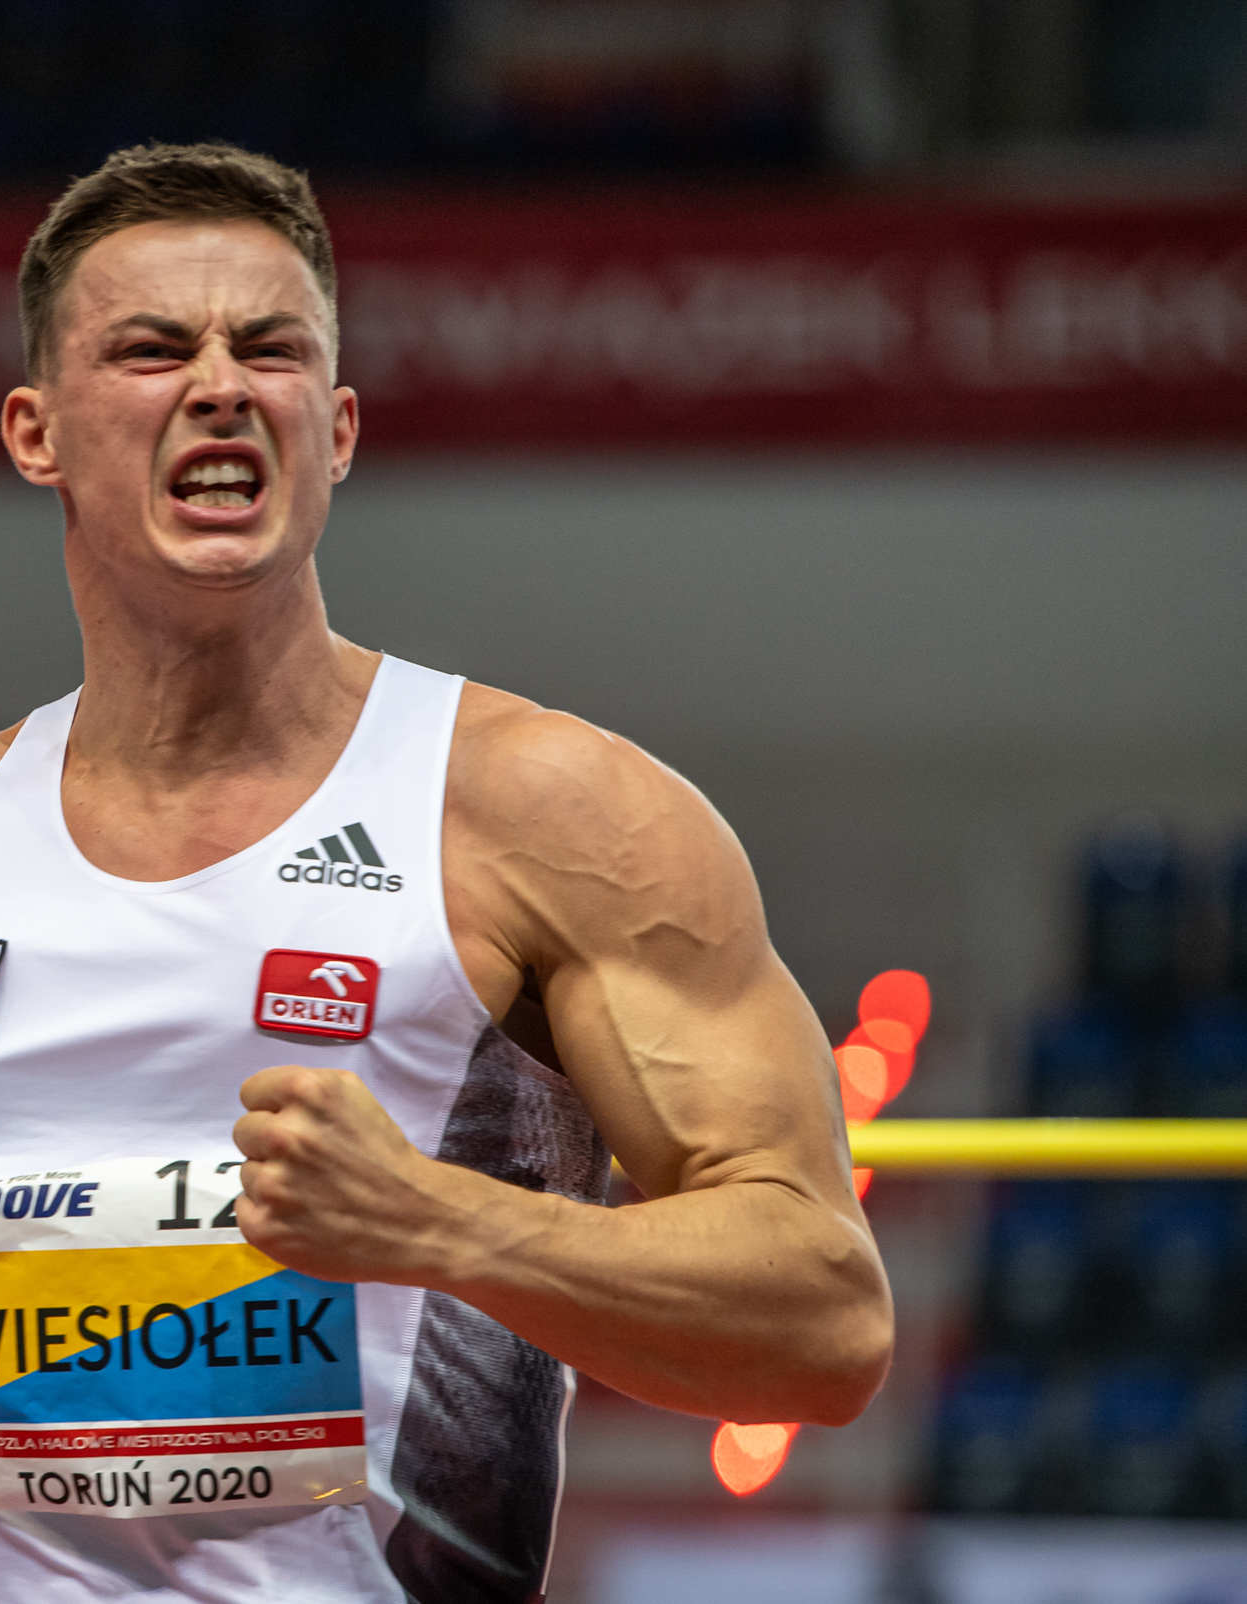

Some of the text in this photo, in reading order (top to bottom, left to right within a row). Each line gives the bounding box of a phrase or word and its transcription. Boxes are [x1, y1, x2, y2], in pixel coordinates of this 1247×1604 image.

[278, 860, 404, 893] adidas
[271, 999, 356, 1026] ORLEN
[44, 1171, 82, 1180] Move
[38, 1434, 115, 1450] HALOWE
[117, 1432, 252, 1448] MISTRZOSTWA
[255, 1426, 325, 1443] POLSKI
[18, 1460, 272, 1506] TORUŃ 2020
